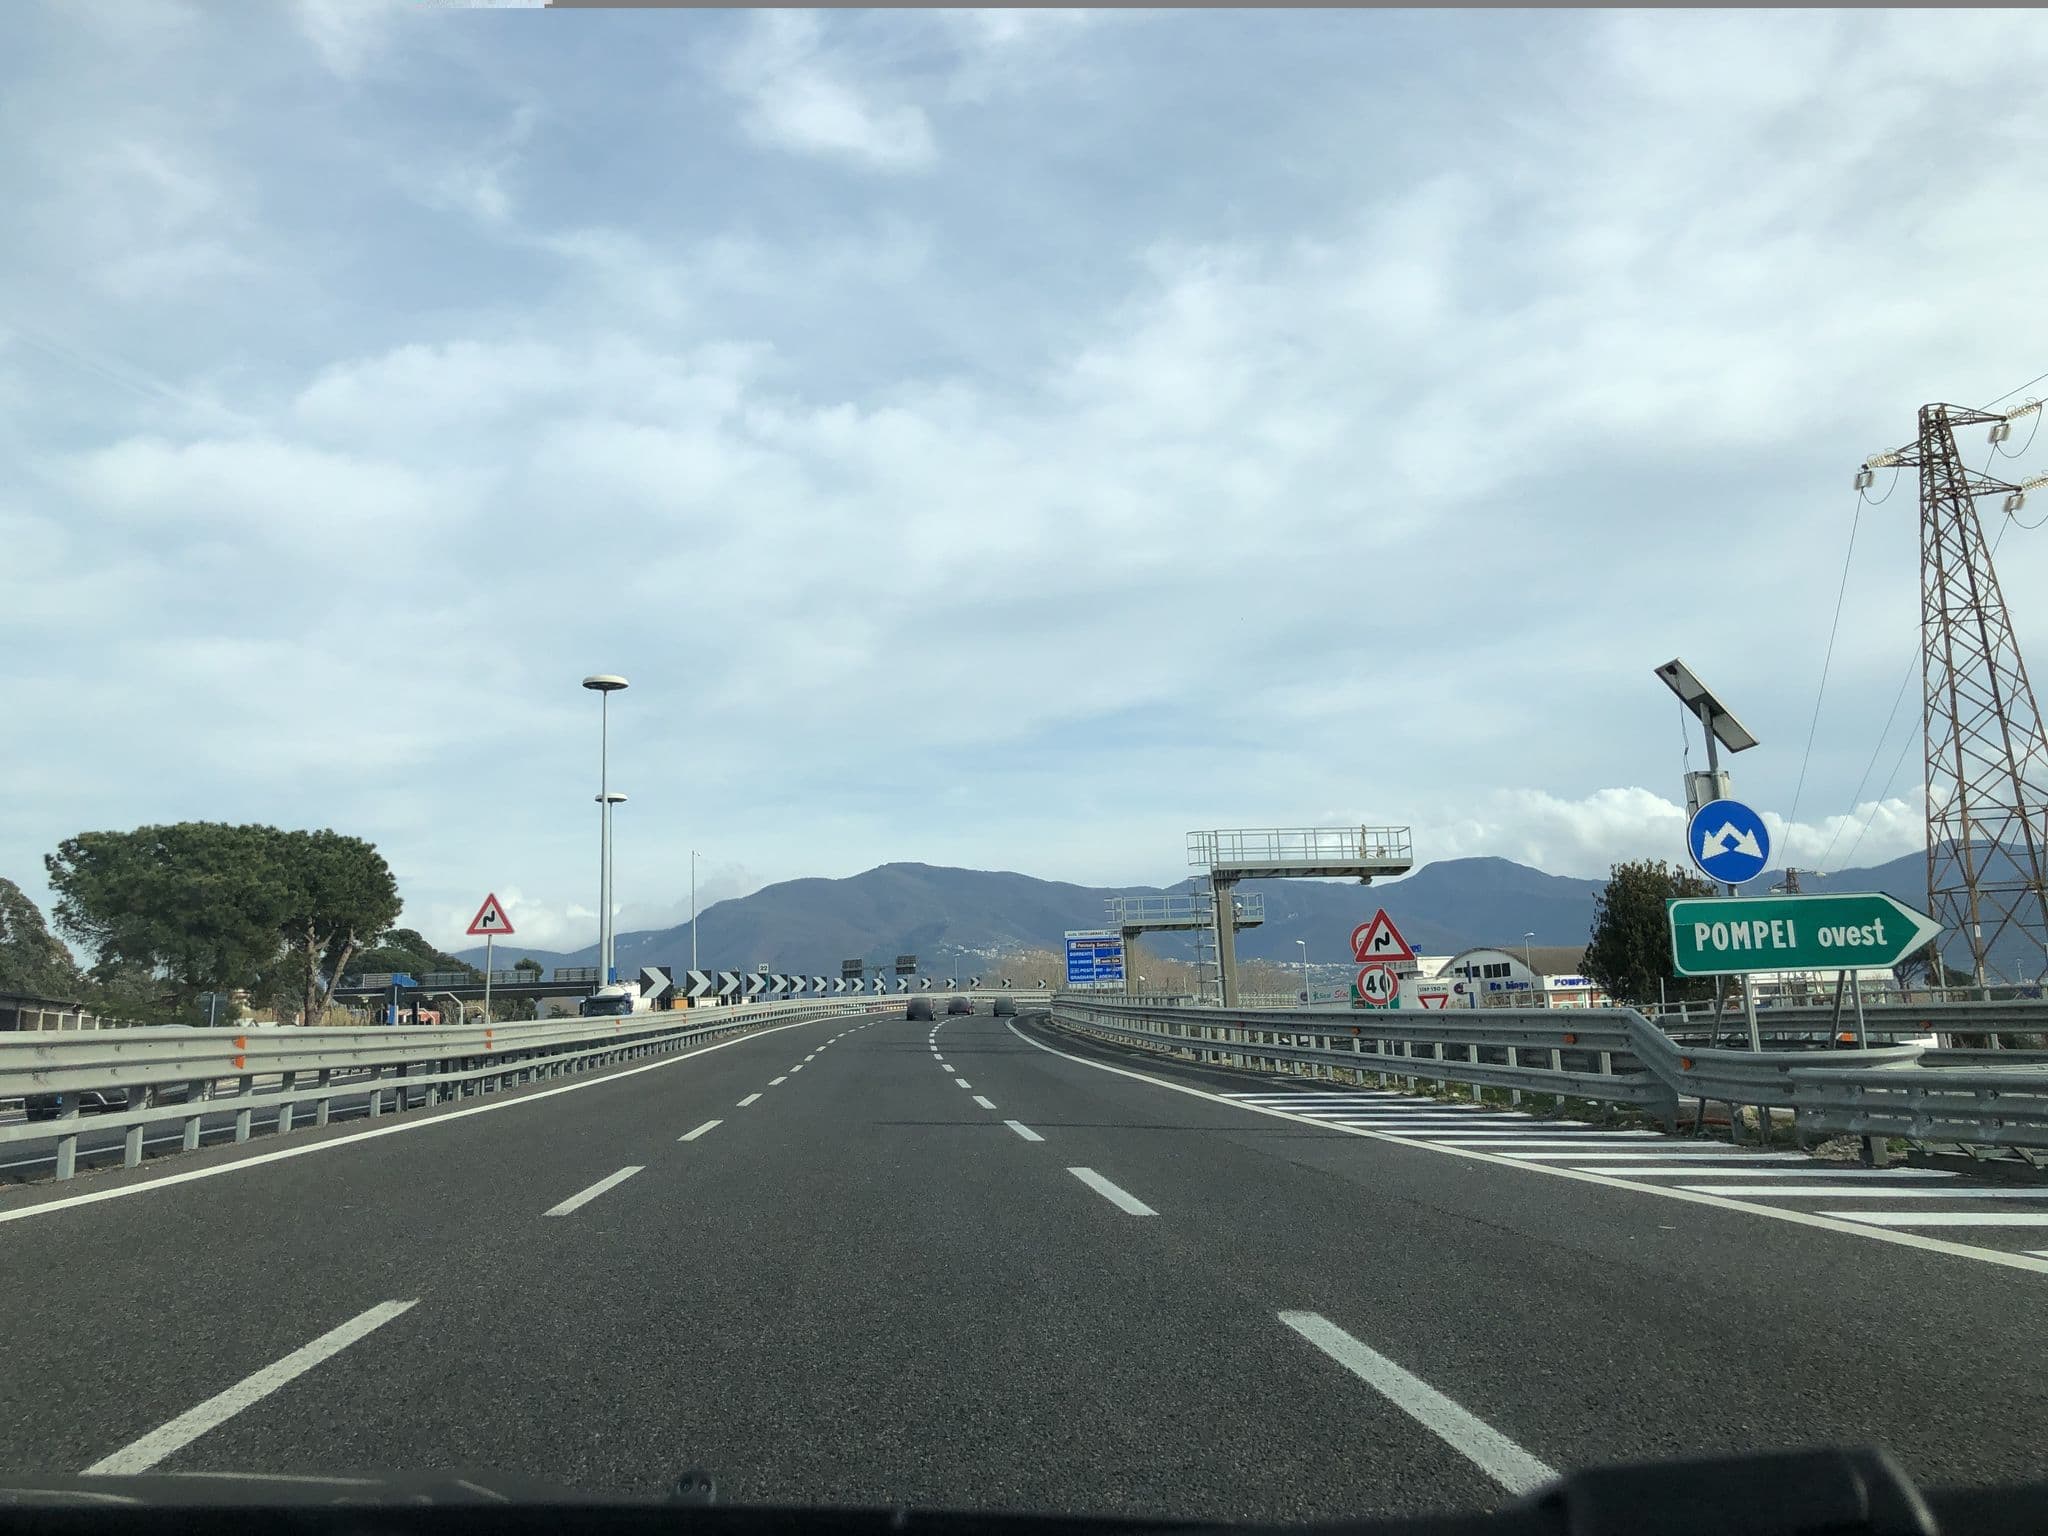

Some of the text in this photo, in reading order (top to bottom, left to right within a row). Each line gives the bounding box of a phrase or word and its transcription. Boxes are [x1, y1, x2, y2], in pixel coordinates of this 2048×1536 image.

[1694, 917, 1888, 951] POMPEI ovest
[1366, 975, 1390, 993] 40
